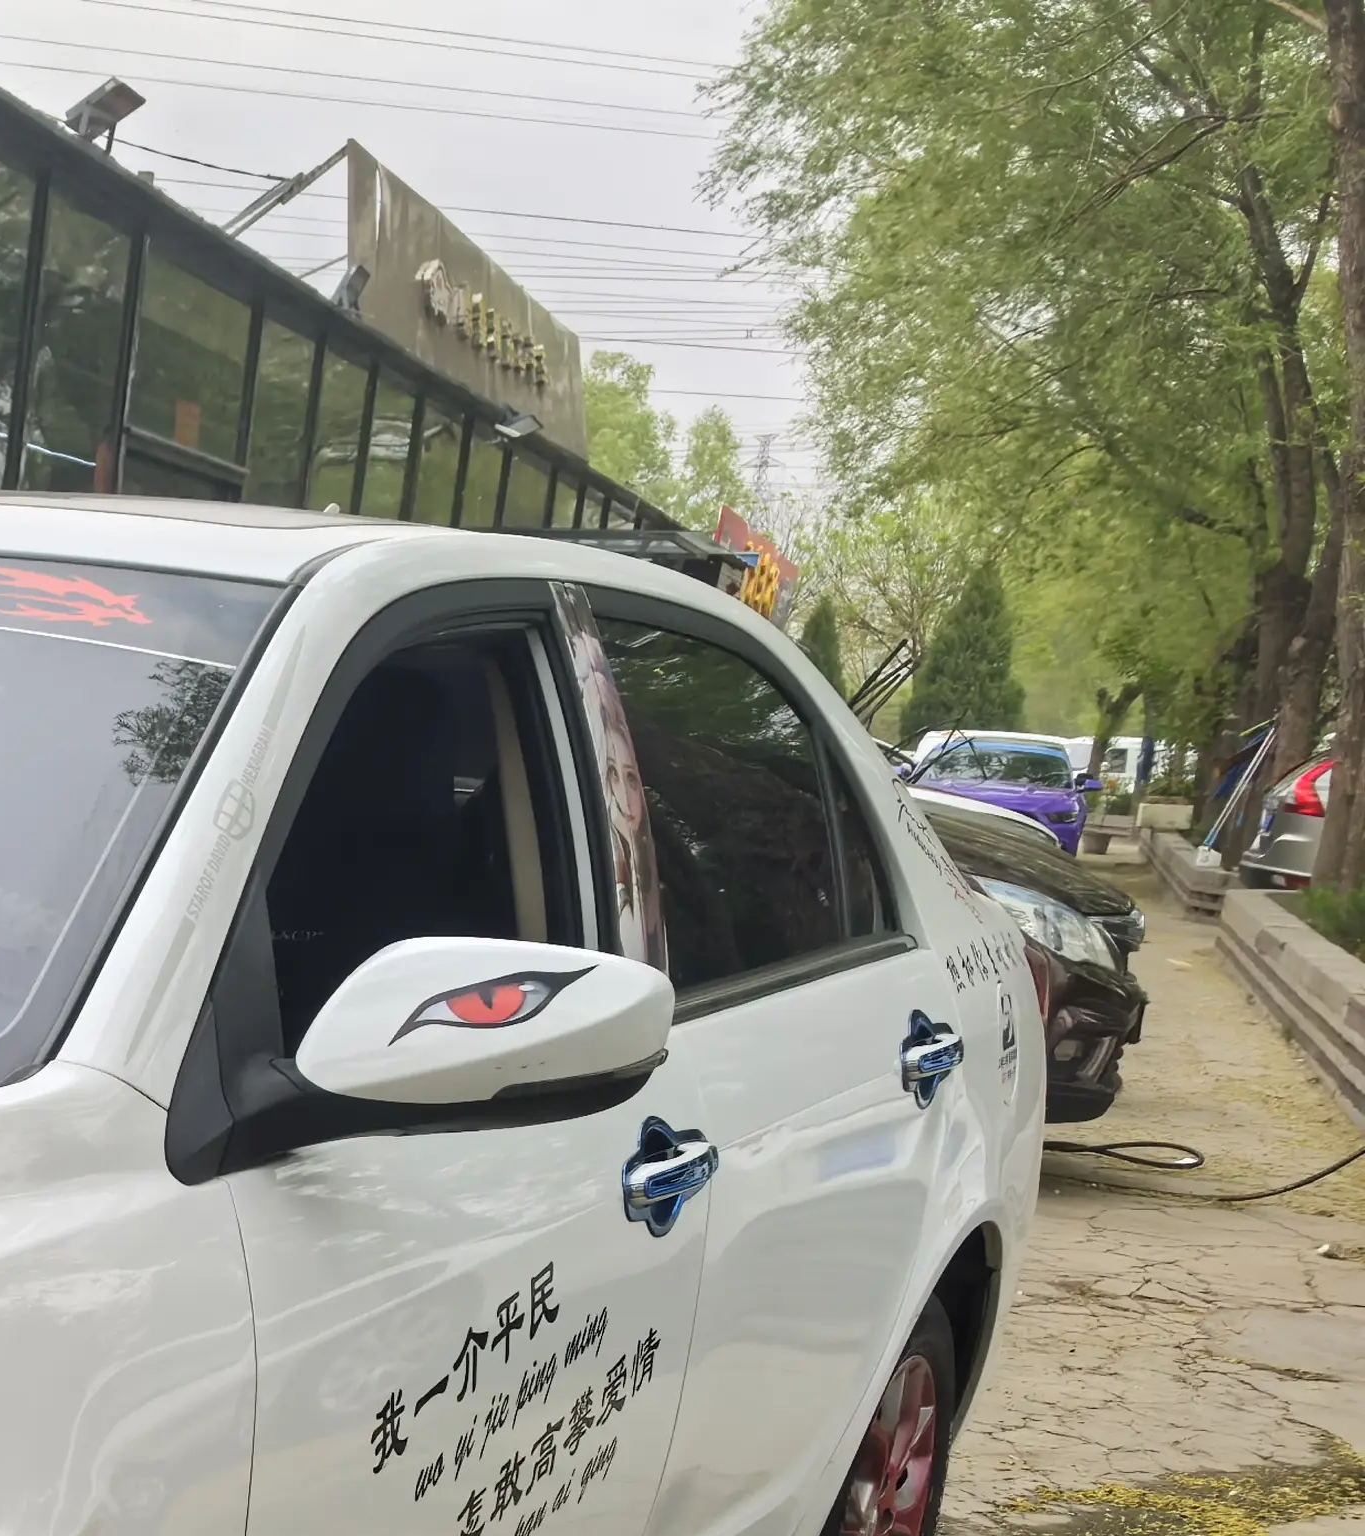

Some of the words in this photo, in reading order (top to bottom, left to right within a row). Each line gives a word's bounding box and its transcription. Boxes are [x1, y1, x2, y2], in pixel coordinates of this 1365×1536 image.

[207, 833, 231, 874] DAVID
[240, 727, 274, 788] HEXAGRAM
[370, 1261, 560, 1474] 我一介平民
[414, 1451, 445, 1502] wo
[454, 1414, 478, 1482] yi
[479, 1393, 510, 1460] jie
[551, 1468, 577, 1513] ai
